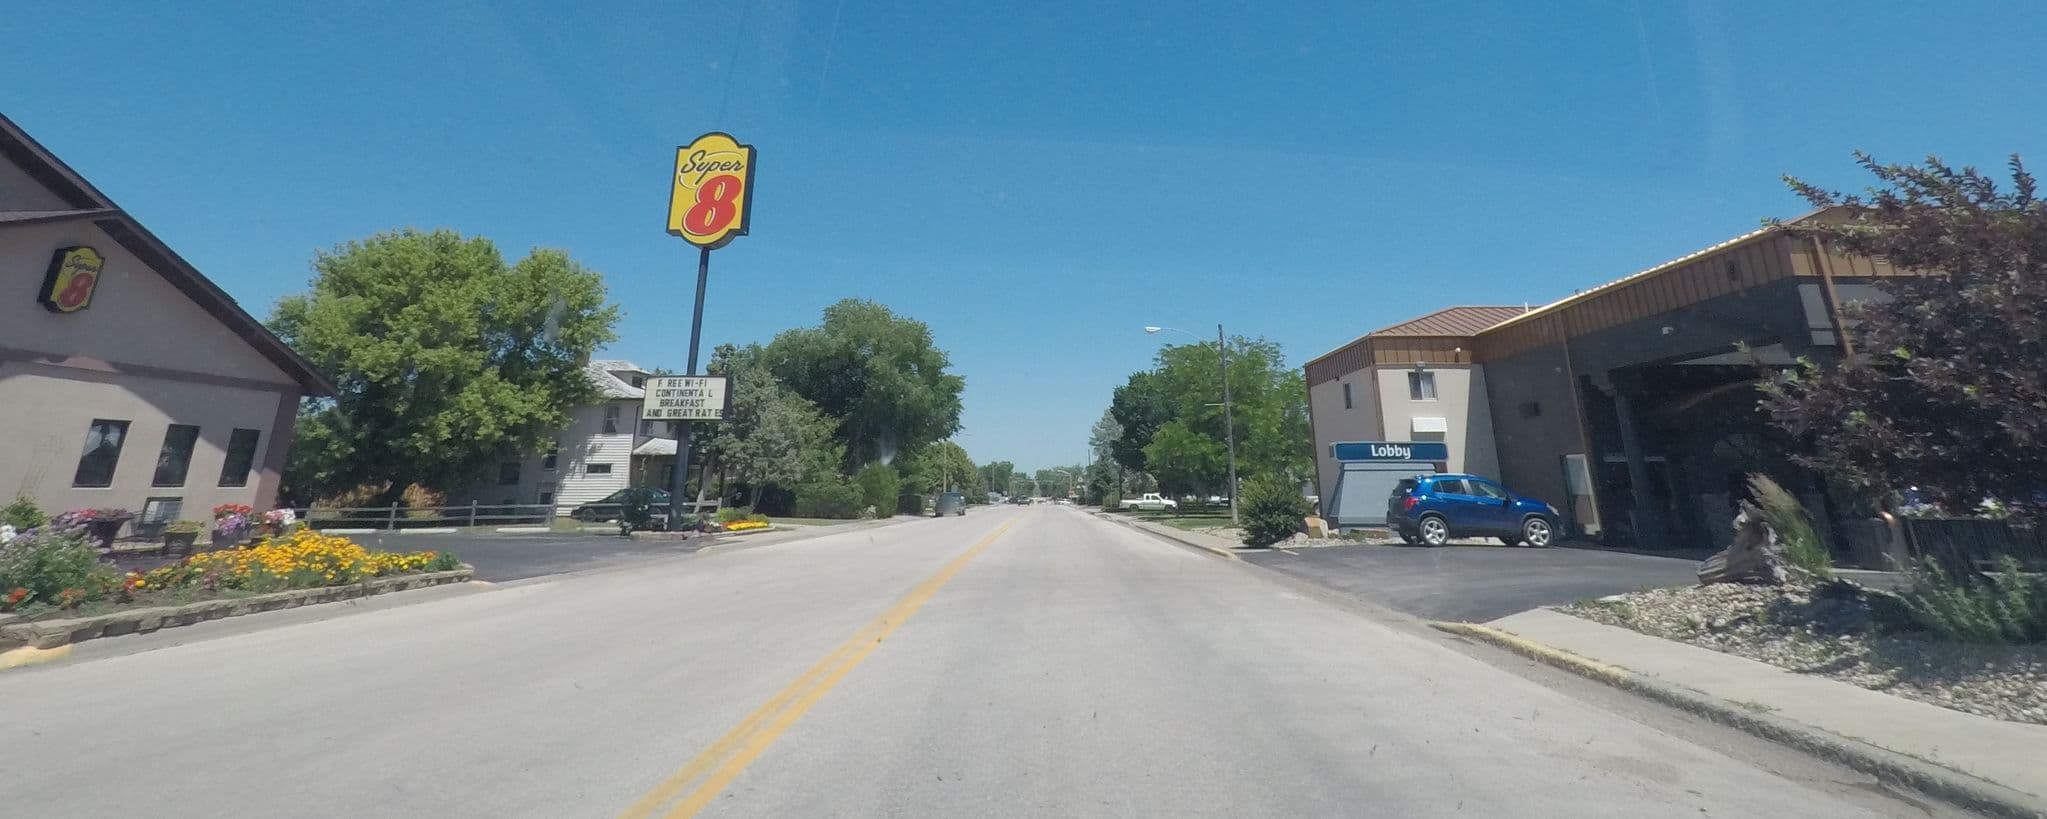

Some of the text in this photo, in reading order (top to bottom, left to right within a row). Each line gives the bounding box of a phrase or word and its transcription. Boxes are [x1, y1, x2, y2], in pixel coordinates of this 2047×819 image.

[680, 150, 744, 185] Super
[682, 174, 742, 236] 8
[60, 272, 93, 307] 8
[659, 399, 705, 407] BREAKFAST
[666, 409, 692, 417] GREAT
[1371, 444, 1411, 459] Lobby
